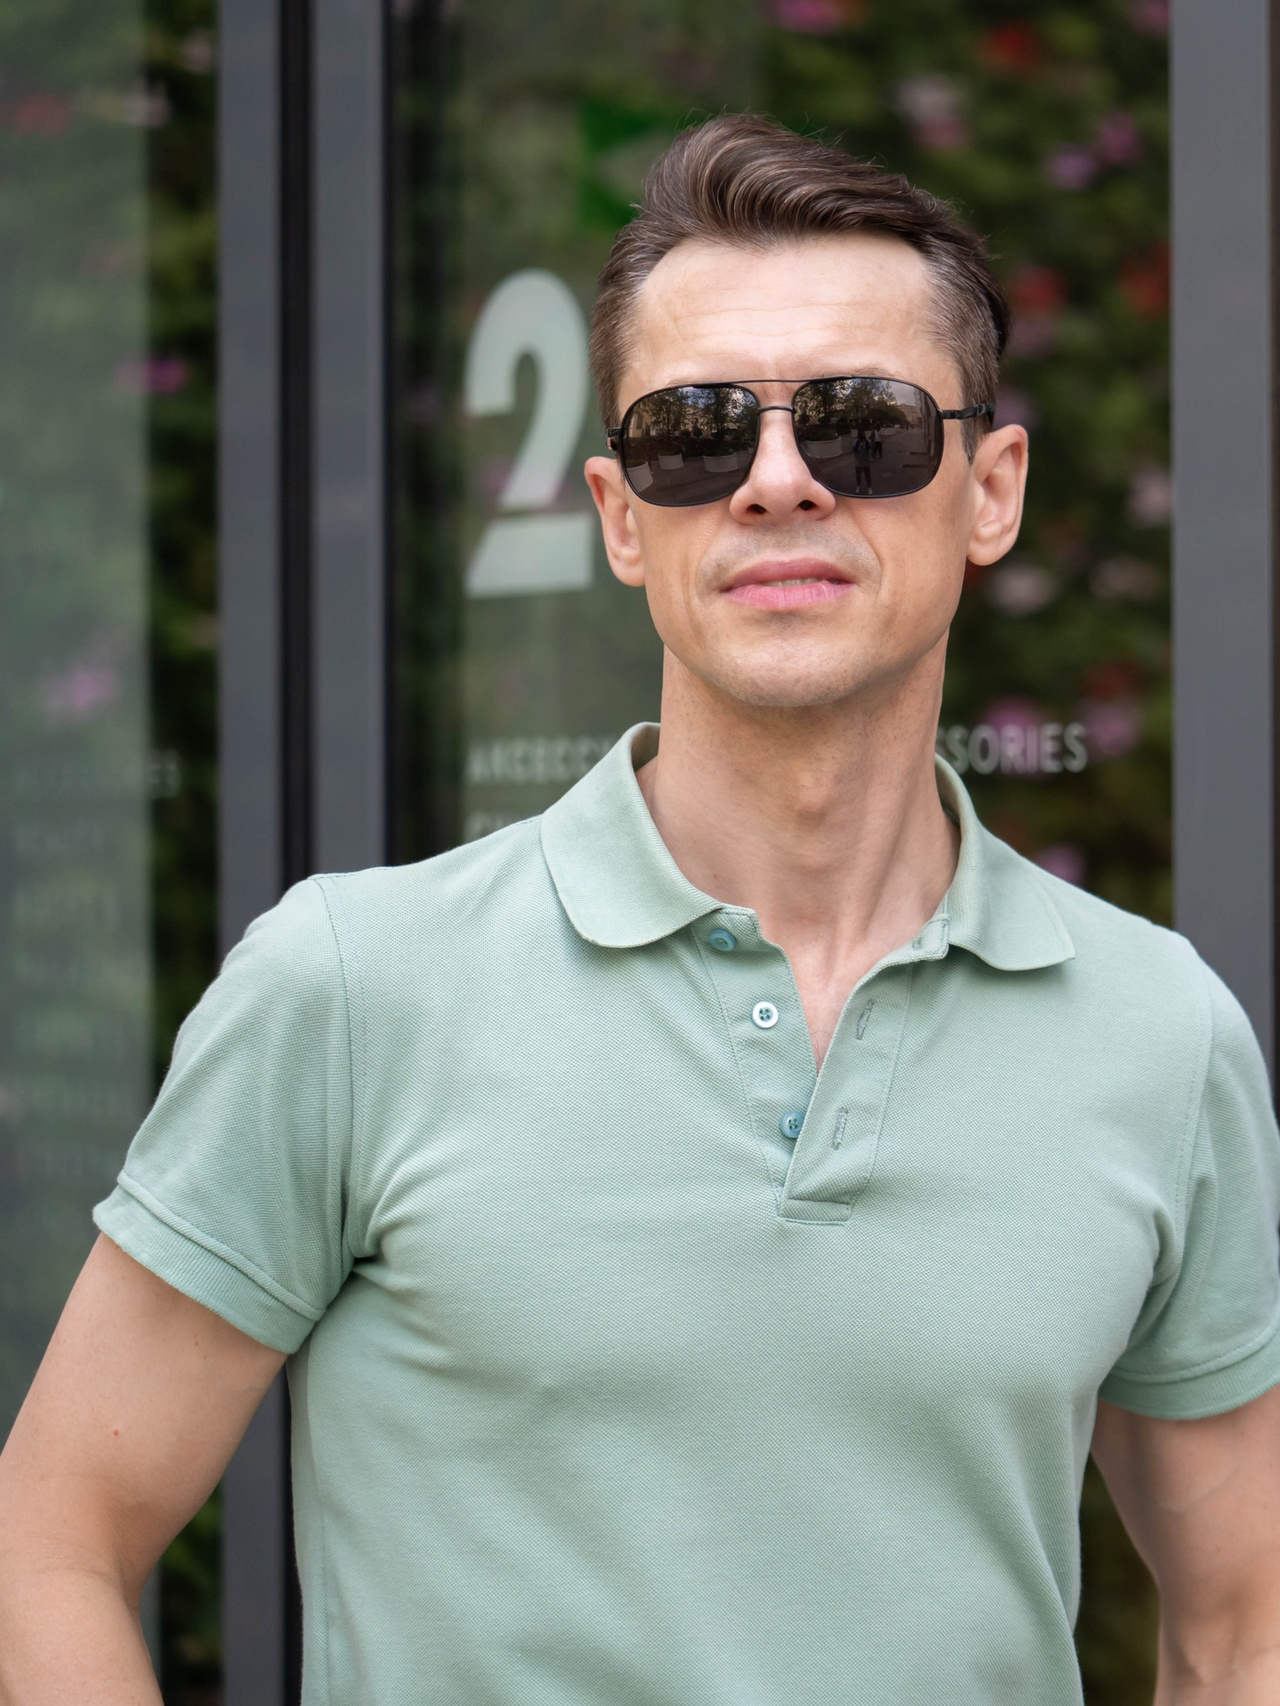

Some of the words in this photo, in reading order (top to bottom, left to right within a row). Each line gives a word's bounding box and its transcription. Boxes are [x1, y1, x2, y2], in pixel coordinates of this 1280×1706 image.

[464, 267, 597, 598] 2
[466, 737, 612, 783] АКСЕСС
[935, 722, 1089, 776] SORIES
